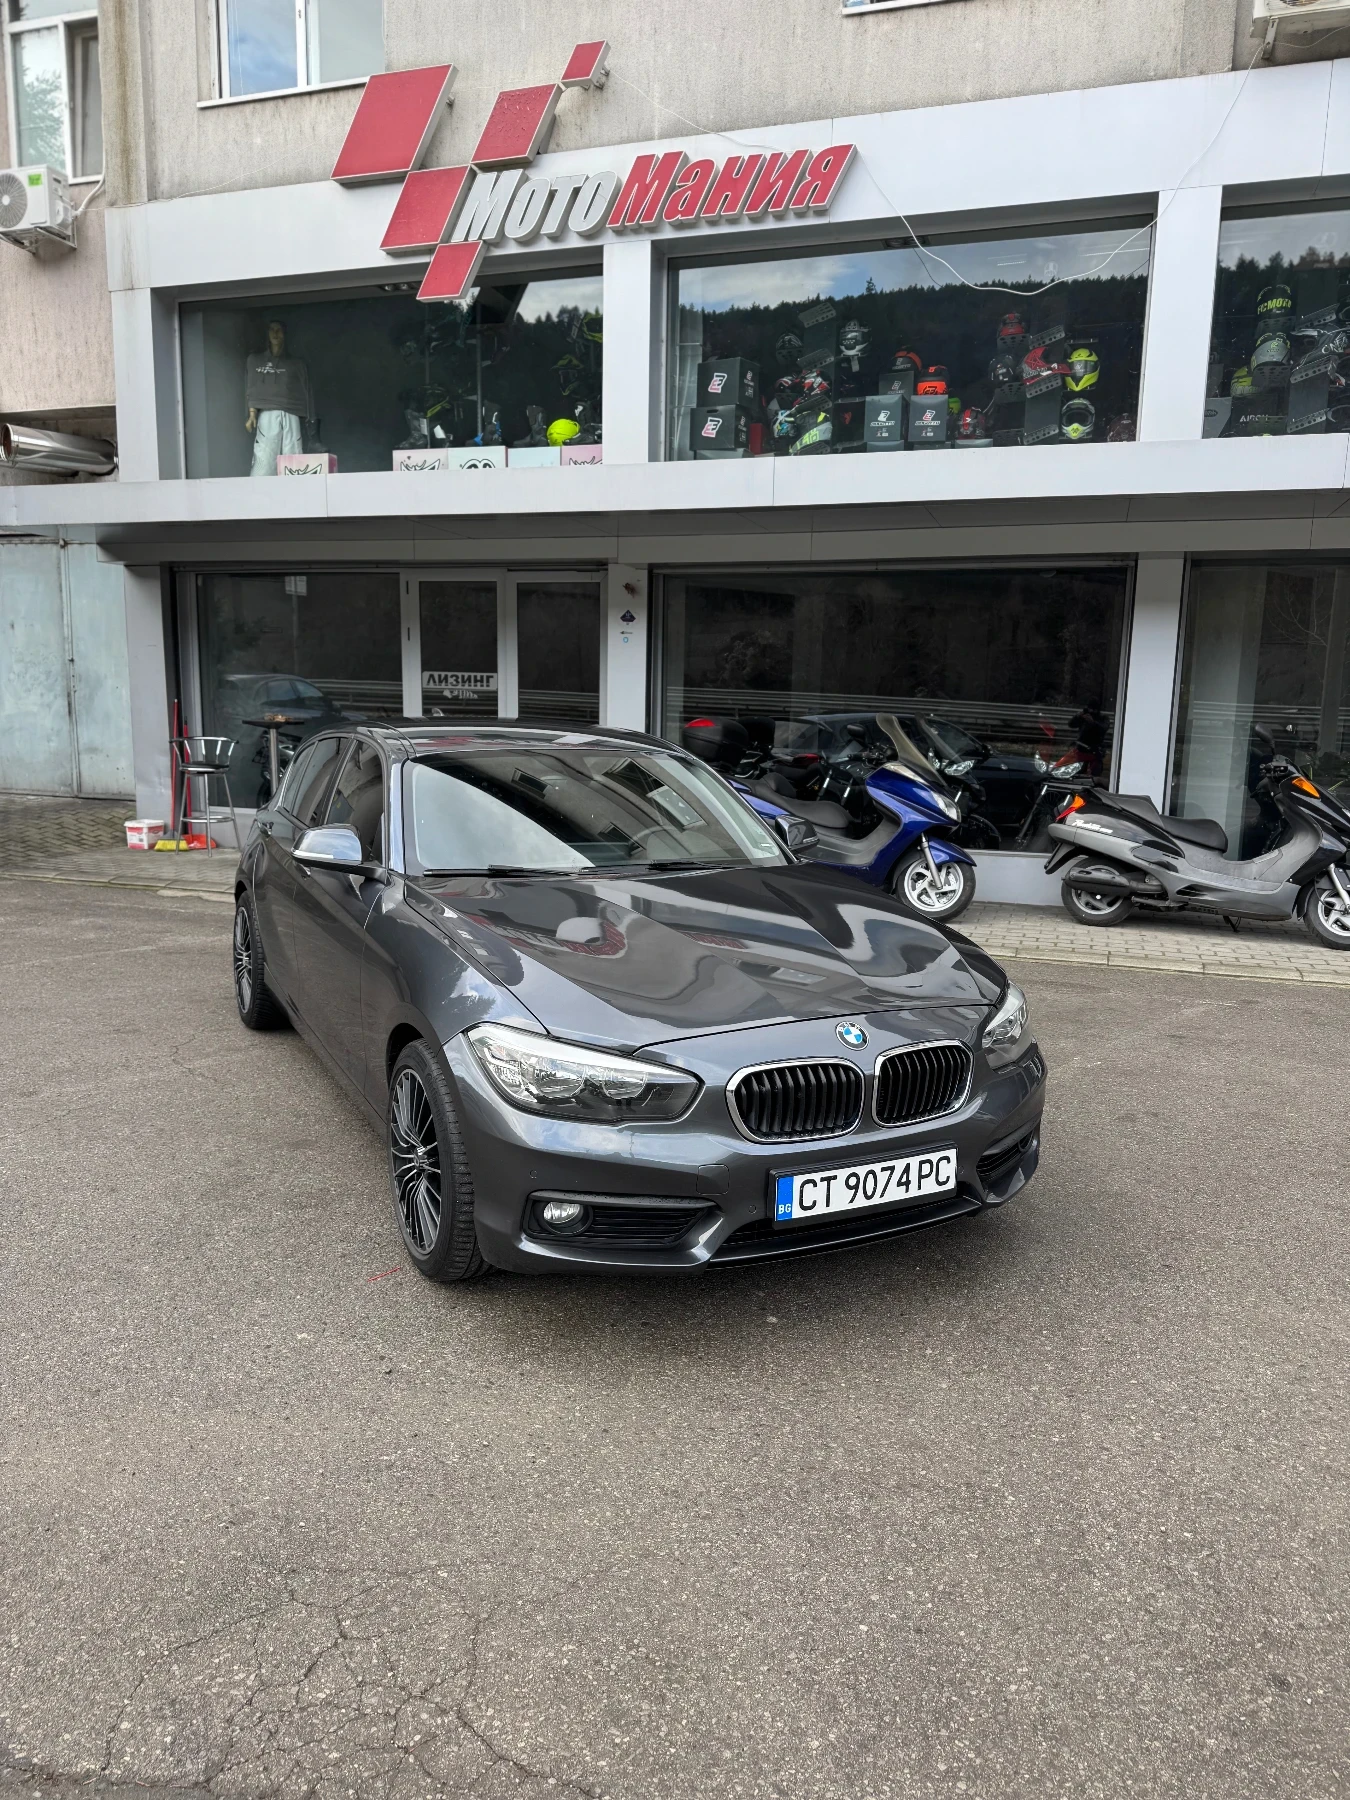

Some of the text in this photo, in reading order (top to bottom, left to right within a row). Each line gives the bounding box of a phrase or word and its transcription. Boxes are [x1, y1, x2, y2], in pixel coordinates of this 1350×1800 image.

[426, 673, 494, 687] ЛИЗИНГ
[798, 1155, 951, 1212] CT 9074 PC
[778, 1203, 792, 1215] BG
